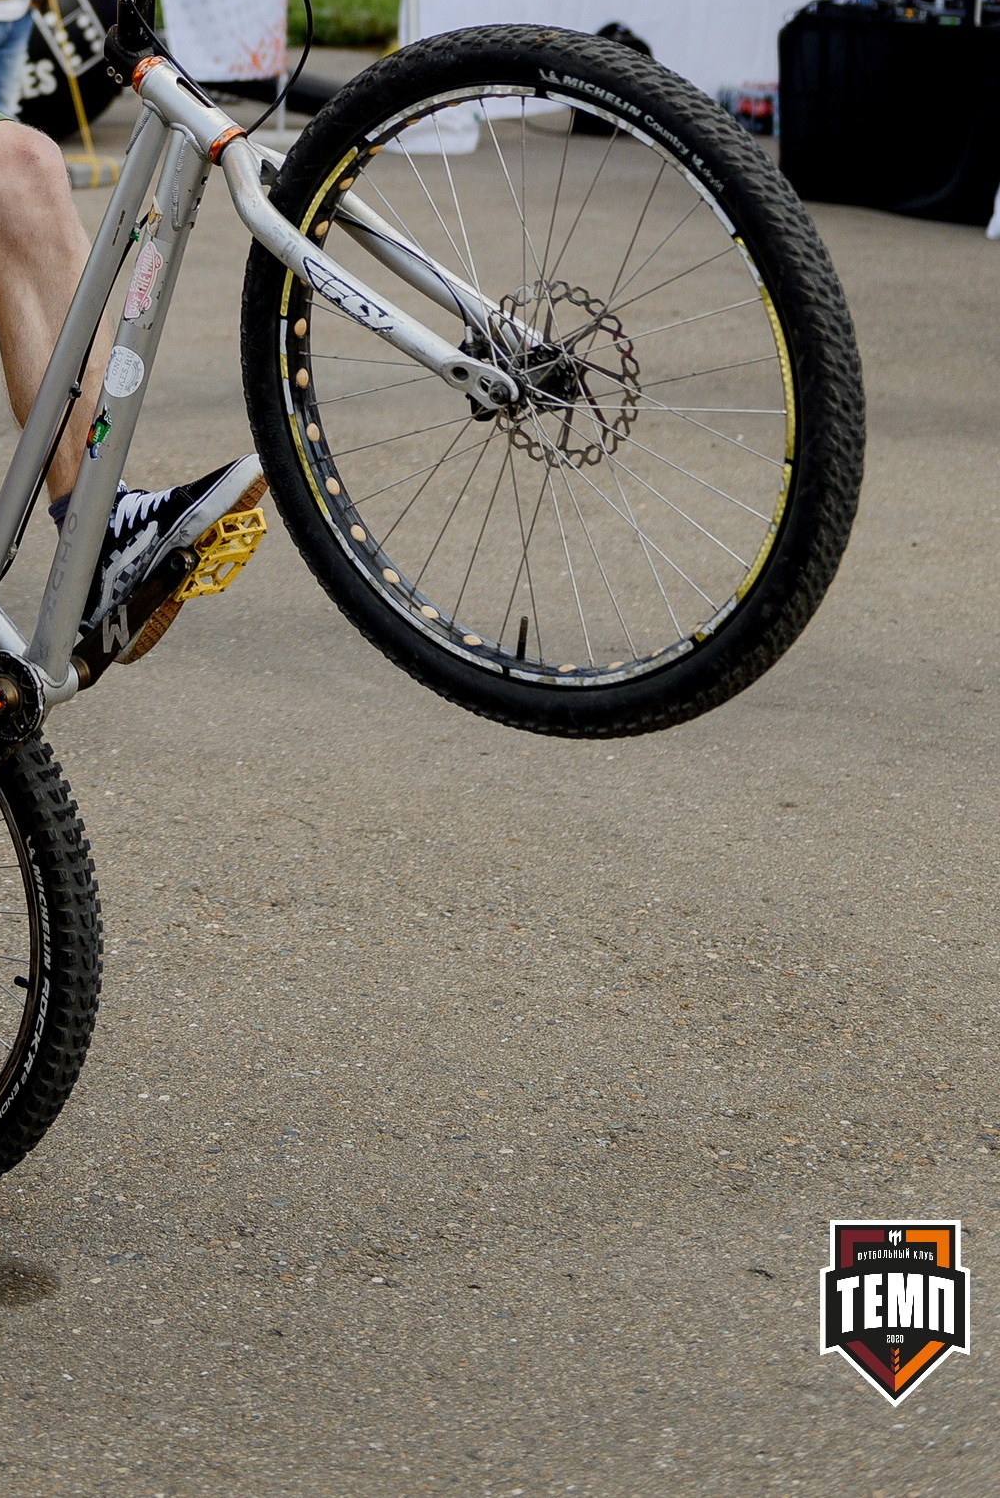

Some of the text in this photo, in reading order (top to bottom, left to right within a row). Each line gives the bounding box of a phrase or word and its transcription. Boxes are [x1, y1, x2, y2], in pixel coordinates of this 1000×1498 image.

[562, 74, 643, 118] MICHELIN
[644, 113, 691, 156] Country
[112, 349, 126, 376] ONLY
[32, 863, 51, 971] MICHELIN
